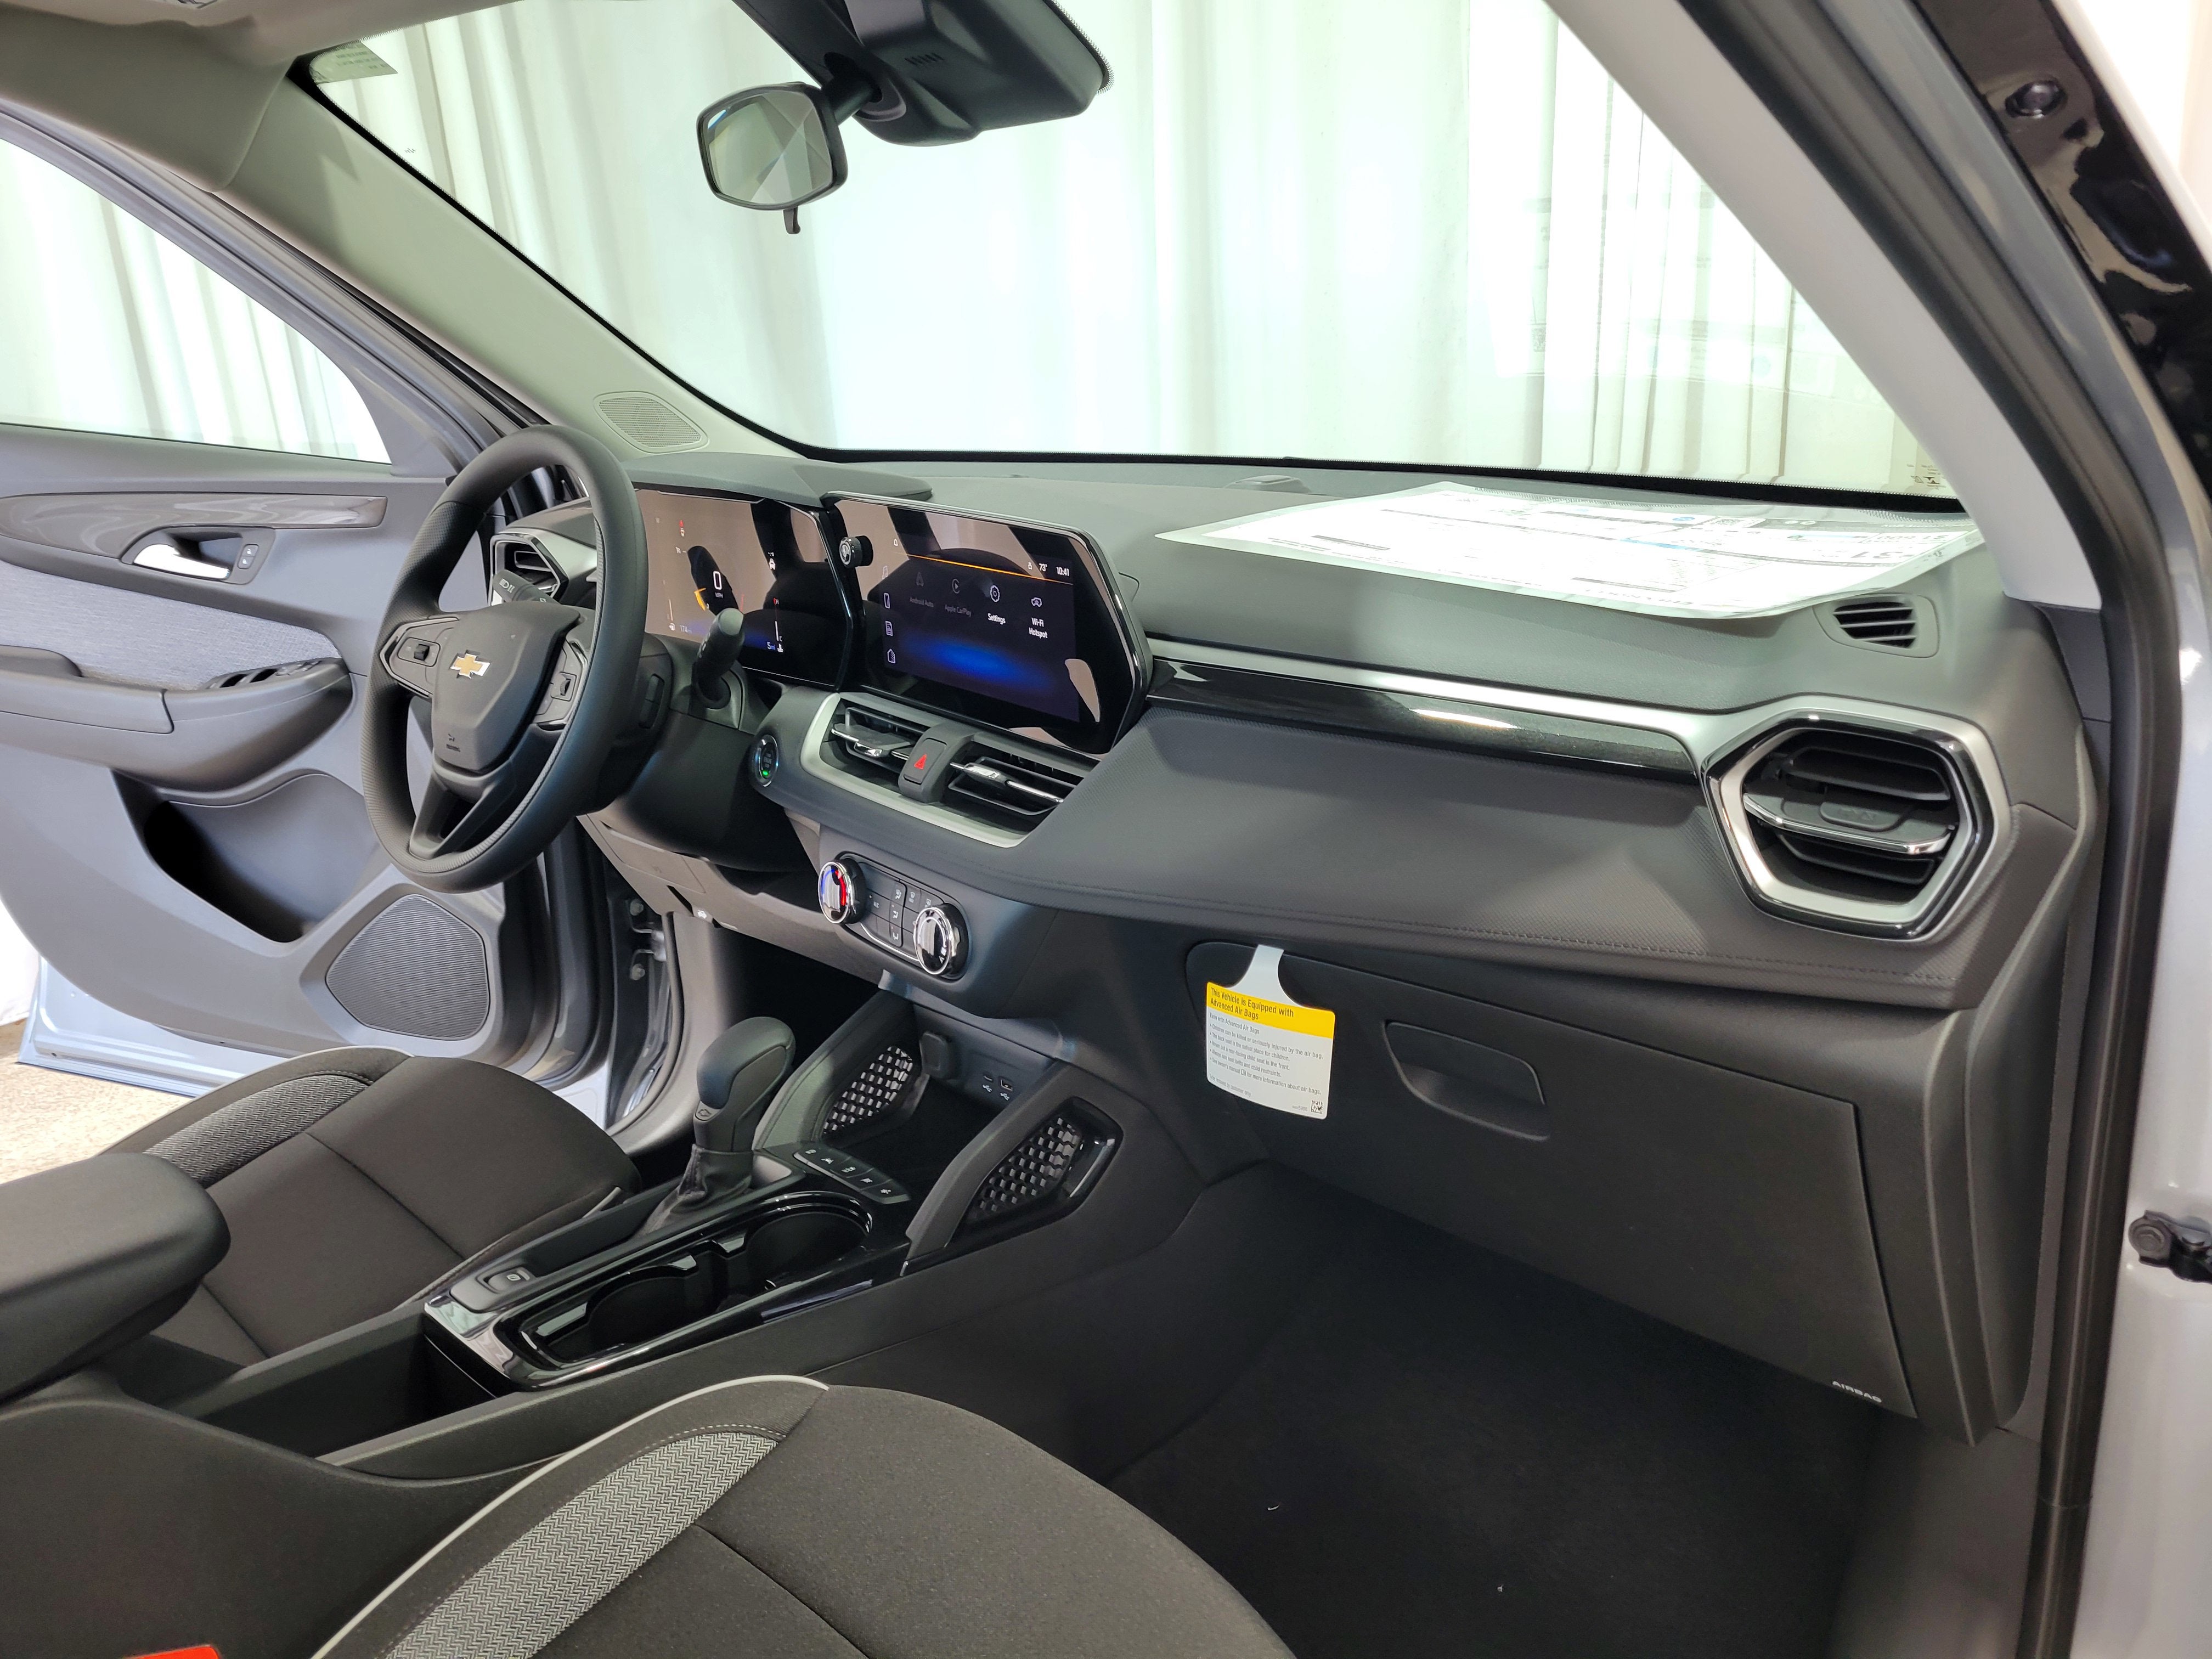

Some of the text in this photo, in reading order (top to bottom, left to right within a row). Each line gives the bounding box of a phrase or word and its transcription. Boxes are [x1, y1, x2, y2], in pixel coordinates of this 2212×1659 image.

[1056, 567, 1069, 577] 10:41
[713, 571, 722, 590] 0
[910, 597, 924, 606] Android
[945, 604, 972, 617] Apple CarPlay
[988, 613, 1006, 625] Settings
[1031, 617, 1044, 627] Wi-Fi
[1029, 627, 1048, 639] Hotspot
[1211, 988, 1220, 998] This
[1221, 991, 1239, 1004] Vehicle
[1248, 1000, 1277, 1014] Equipped
[1279, 1008, 1294, 1018] with
[1211, 997, 1233, 1013] Advanced
[1244, 1009, 1259, 1020] Bags
[1226, 1018, 1243, 1029] Advanced
[1250, 1026, 1260, 1035] Bags
[1272, 1043, 1287, 1052] injured
[1271, 1052, 1290, 1062] children.
[1263, 1076, 1286, 1087] information
[1832, 1380, 1882, 1403] AIRBAG
